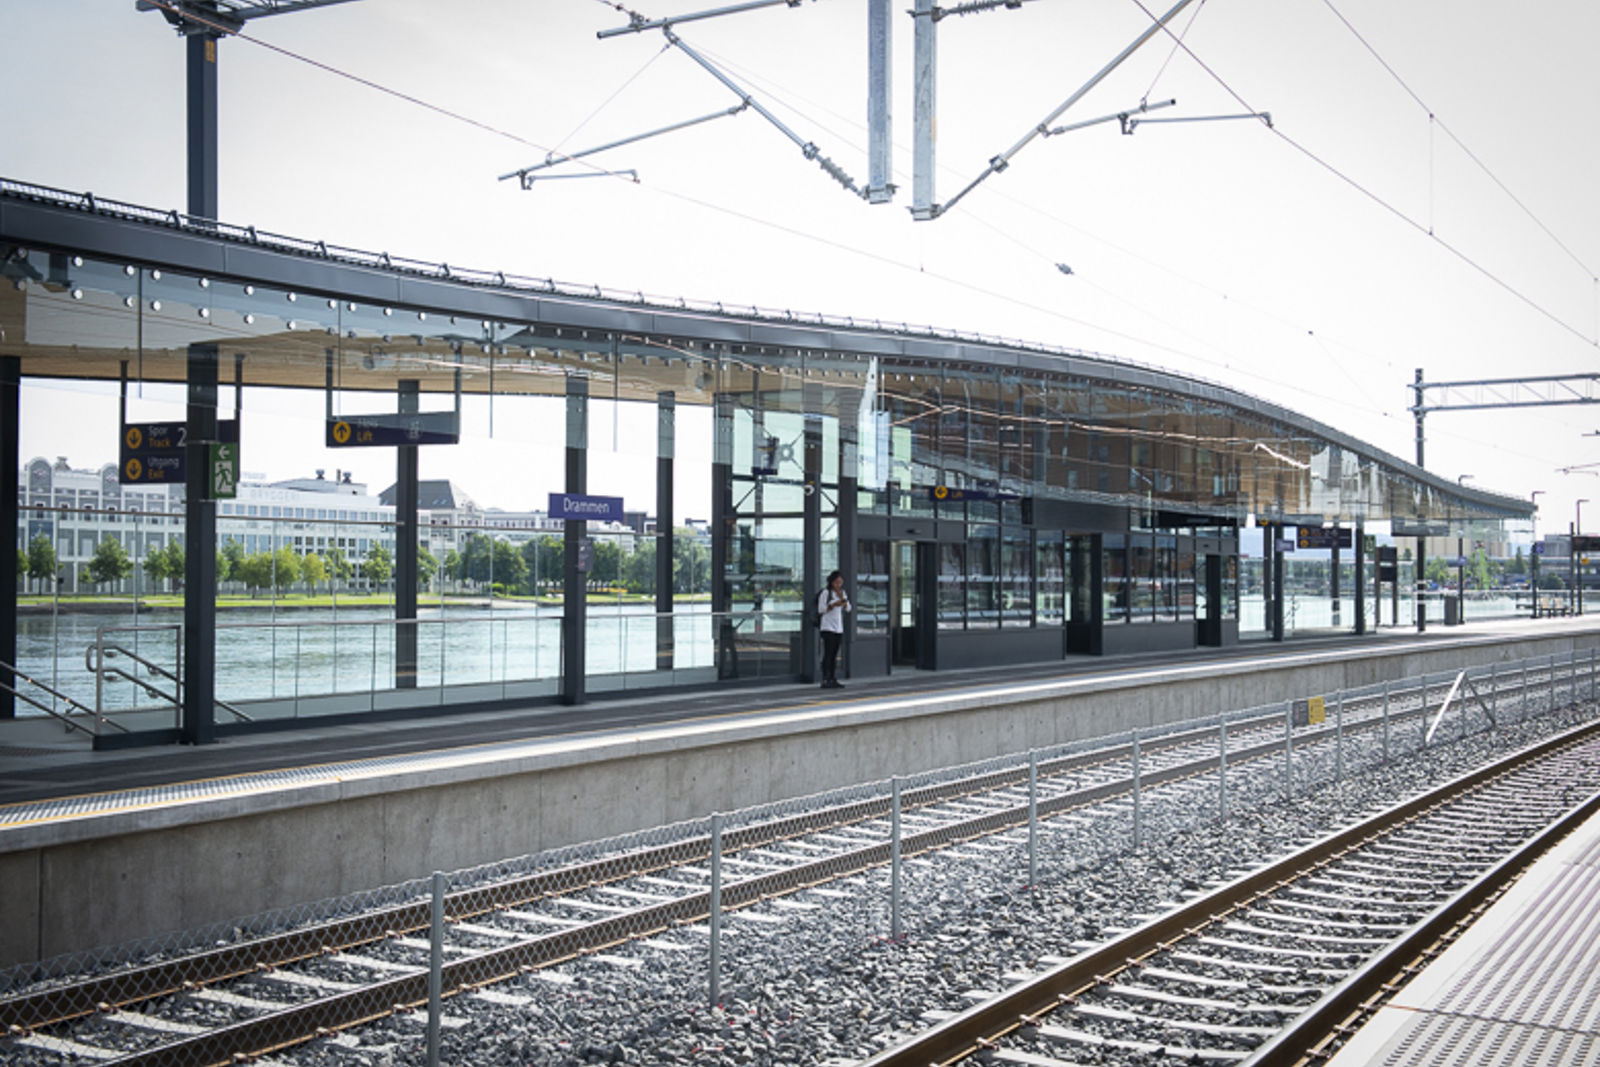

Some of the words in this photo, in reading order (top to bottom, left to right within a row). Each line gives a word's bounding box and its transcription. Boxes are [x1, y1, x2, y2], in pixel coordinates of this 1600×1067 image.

[148, 425, 168, 437] Spor
[176, 427, 187, 447] 2
[357, 431, 373, 442] Lift
[148, 437, 171, 448] Track
[147, 456, 179, 469] Utgang
[147, 469, 165, 479] Exit
[563, 497, 610, 514] Drammen
